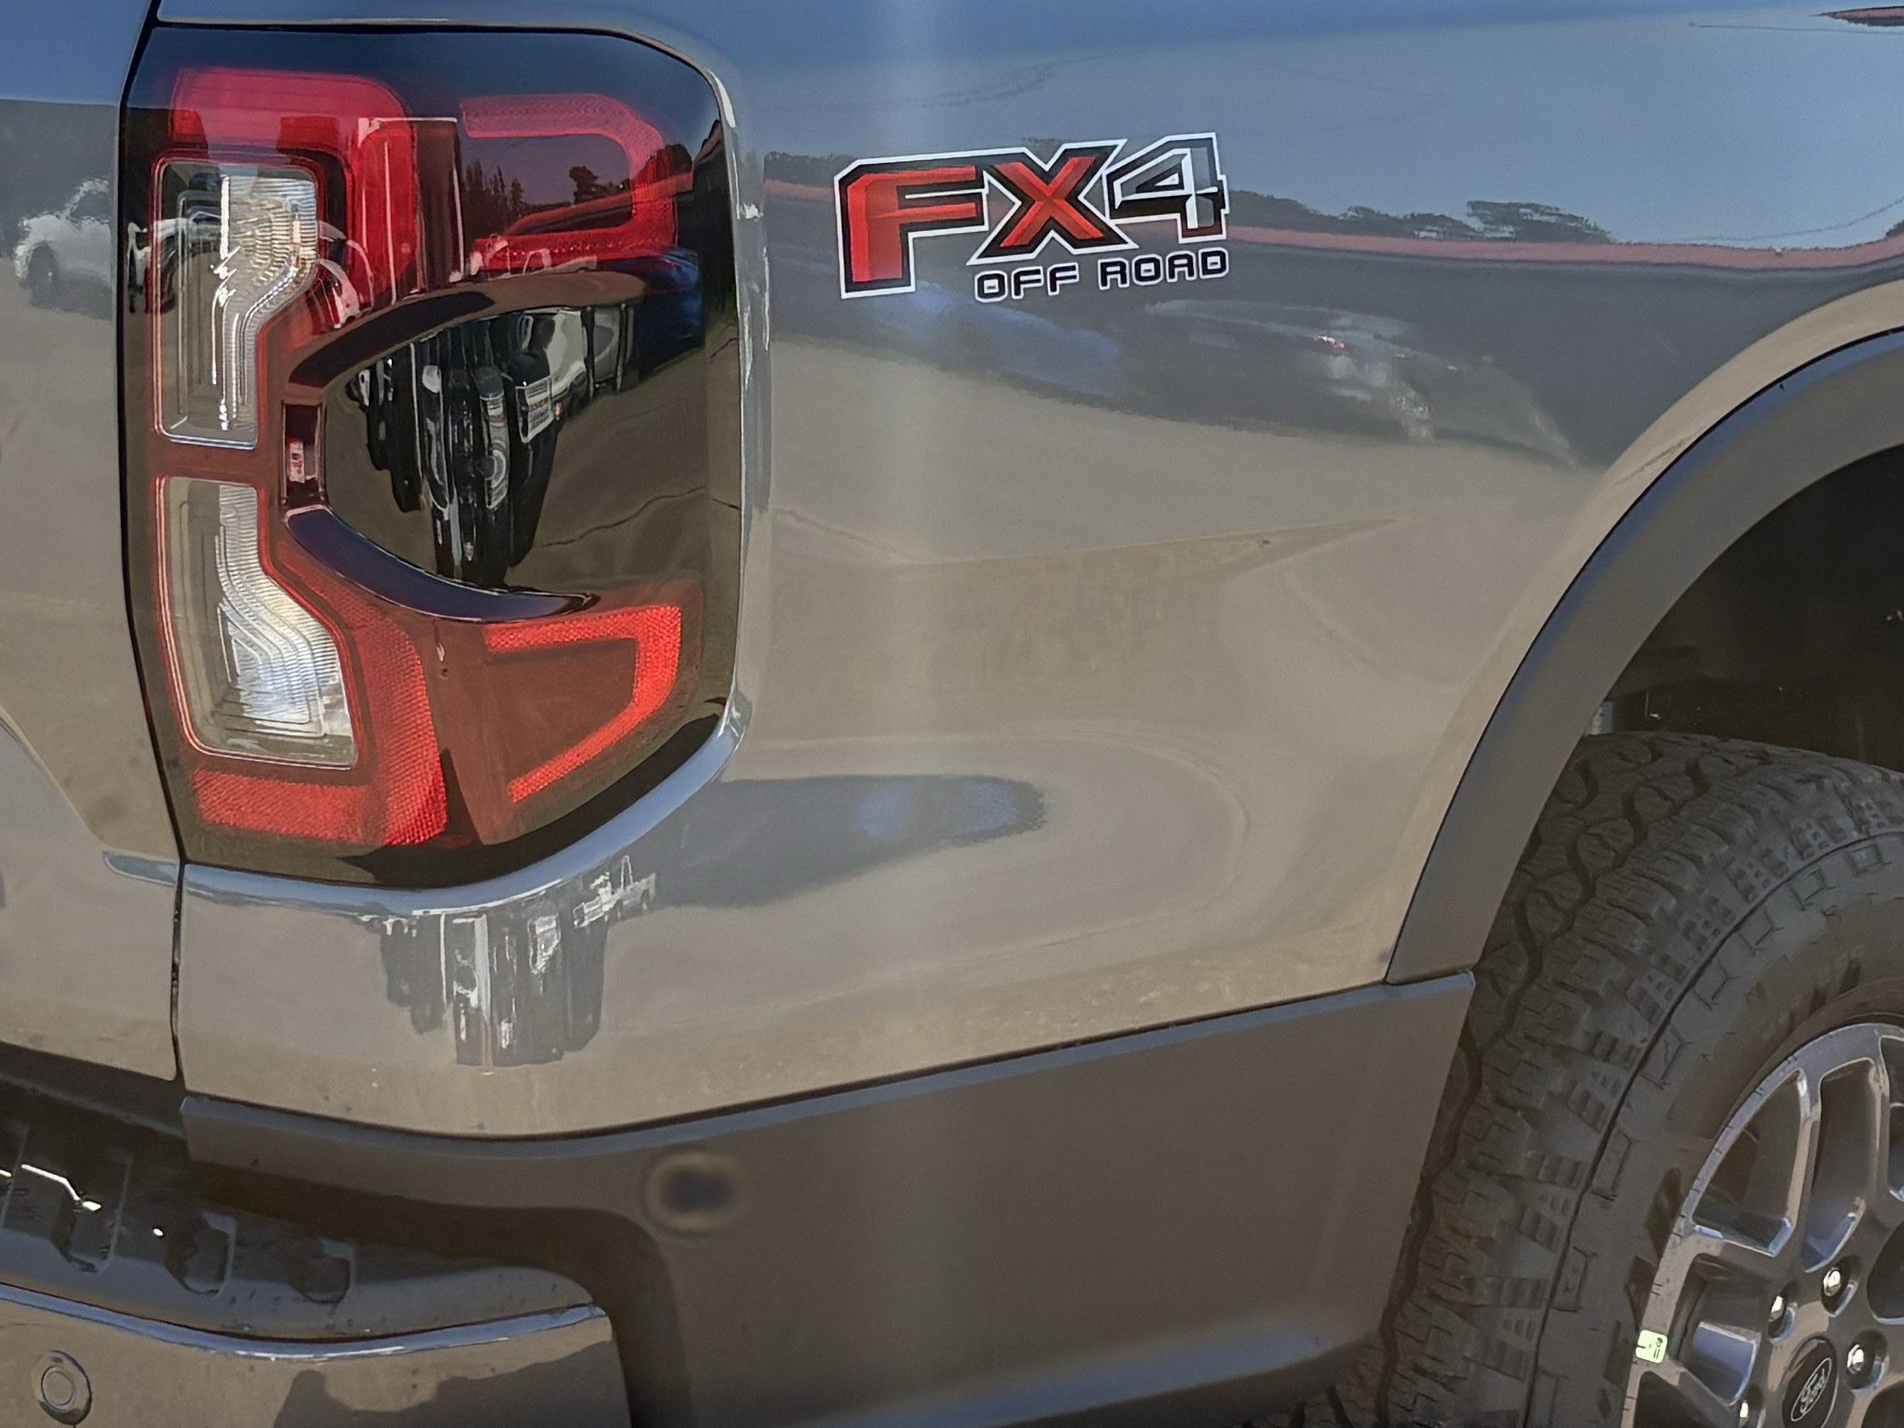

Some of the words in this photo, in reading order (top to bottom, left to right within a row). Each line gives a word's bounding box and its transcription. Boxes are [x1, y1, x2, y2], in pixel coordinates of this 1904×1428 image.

[834, 132, 1230, 299] FX4
[974, 262, 1080, 303] OFF
[1098, 247, 1230, 289] ROAD
